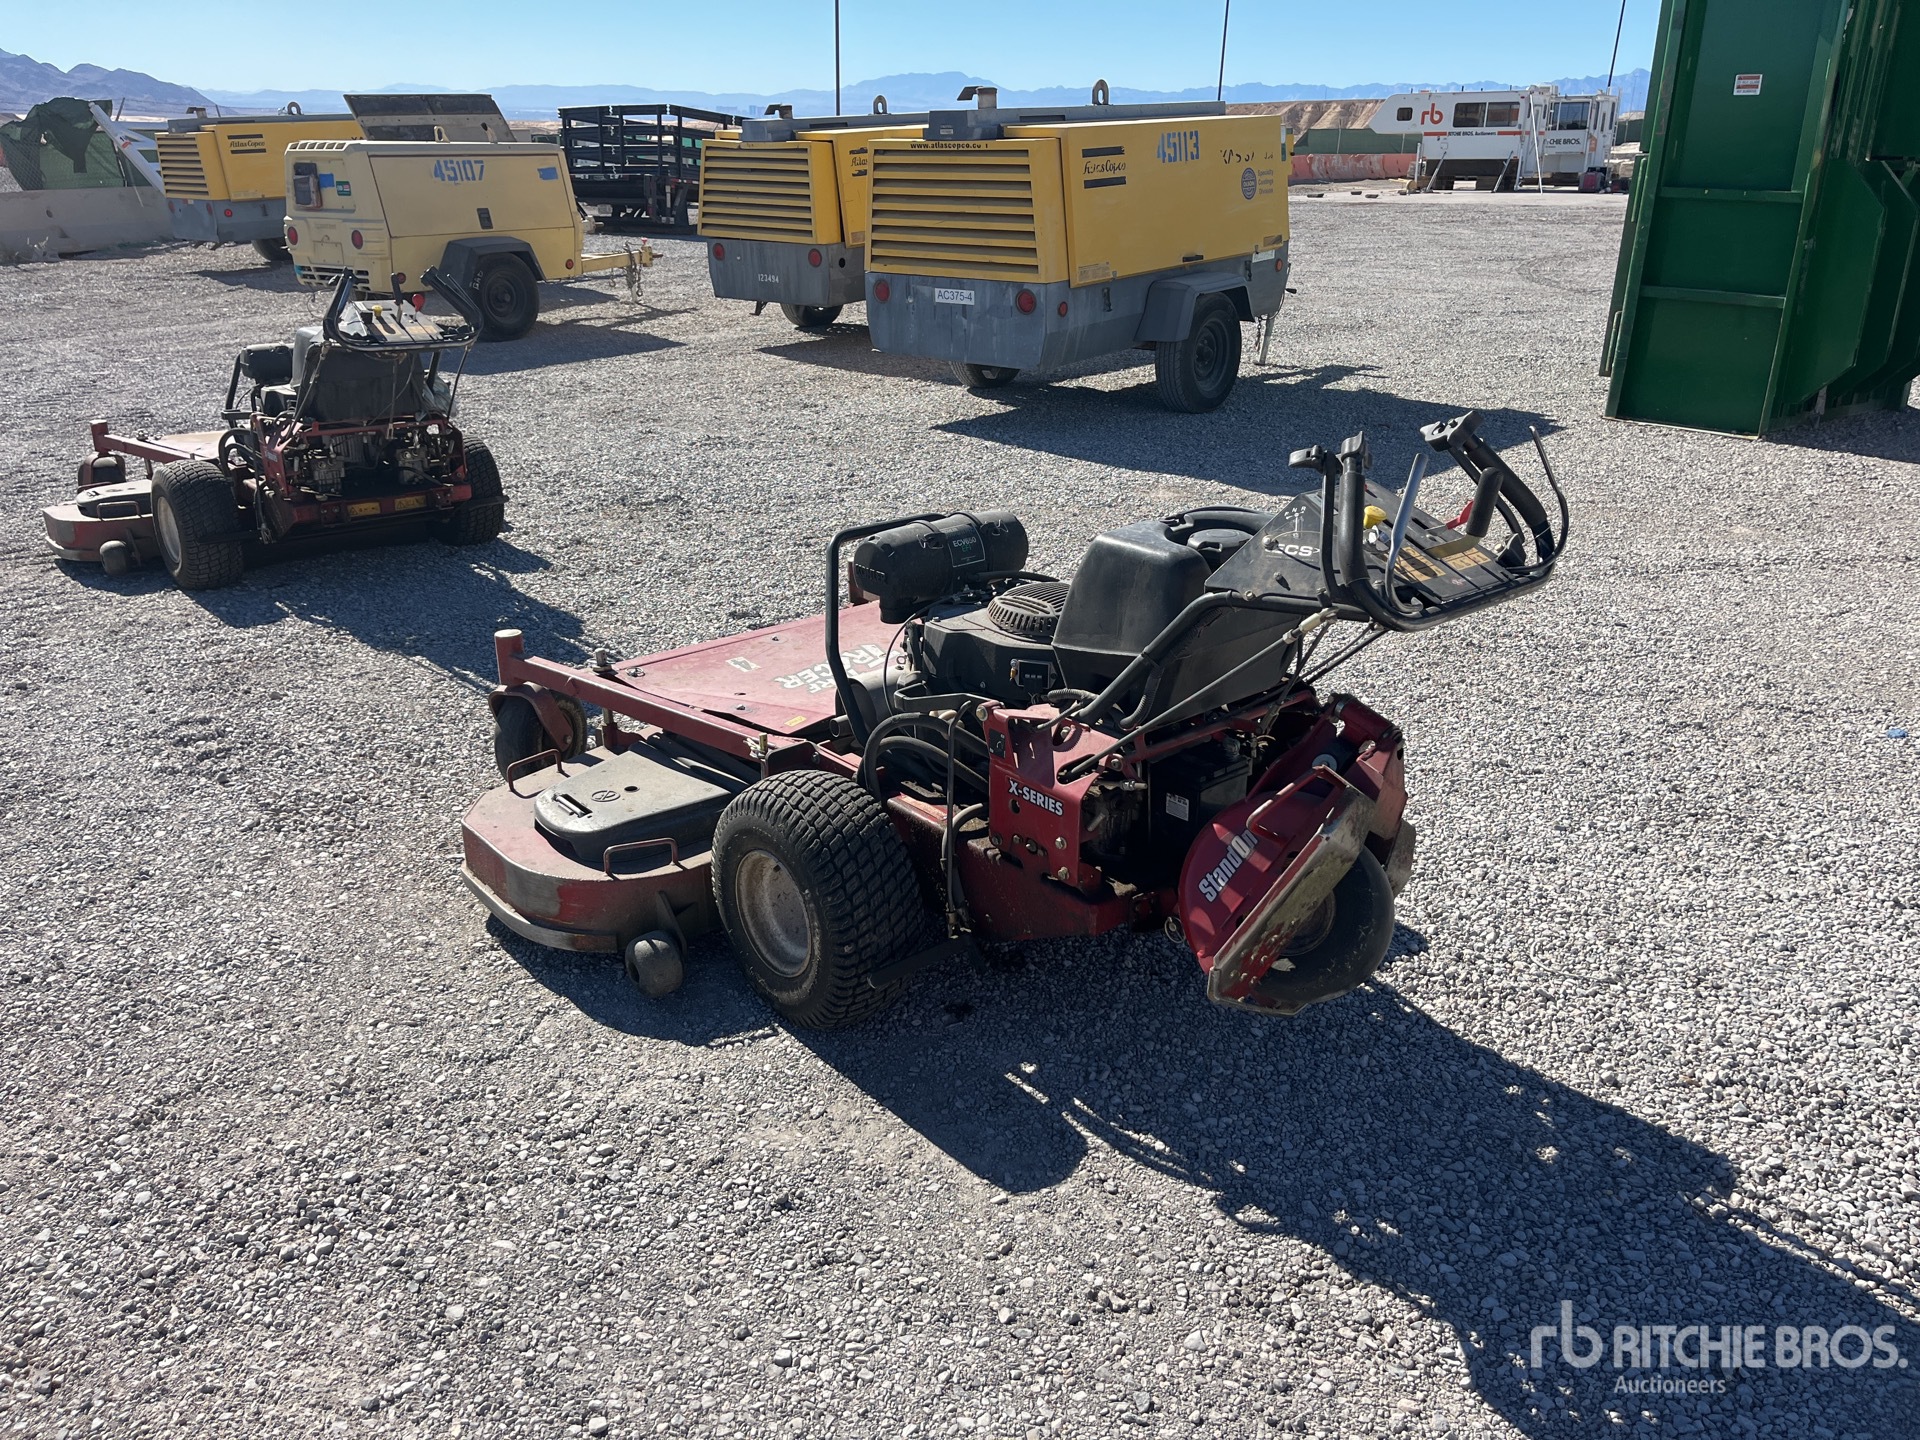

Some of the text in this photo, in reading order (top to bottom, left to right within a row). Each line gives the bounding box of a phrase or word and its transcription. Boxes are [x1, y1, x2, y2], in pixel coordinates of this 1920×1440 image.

[1421, 103, 1443, 125] rb
[230, 140, 247, 148] Atlas
[910, 141, 988, 150] www.atlascopco.co
[1156, 130, 1200, 164] 45113
[433, 159, 485, 182] 45107
[937, 290, 972, 301] AC375-4
[1008, 777, 1063, 816] X-SERIES
[1199, 829, 1258, 902] StandOn
